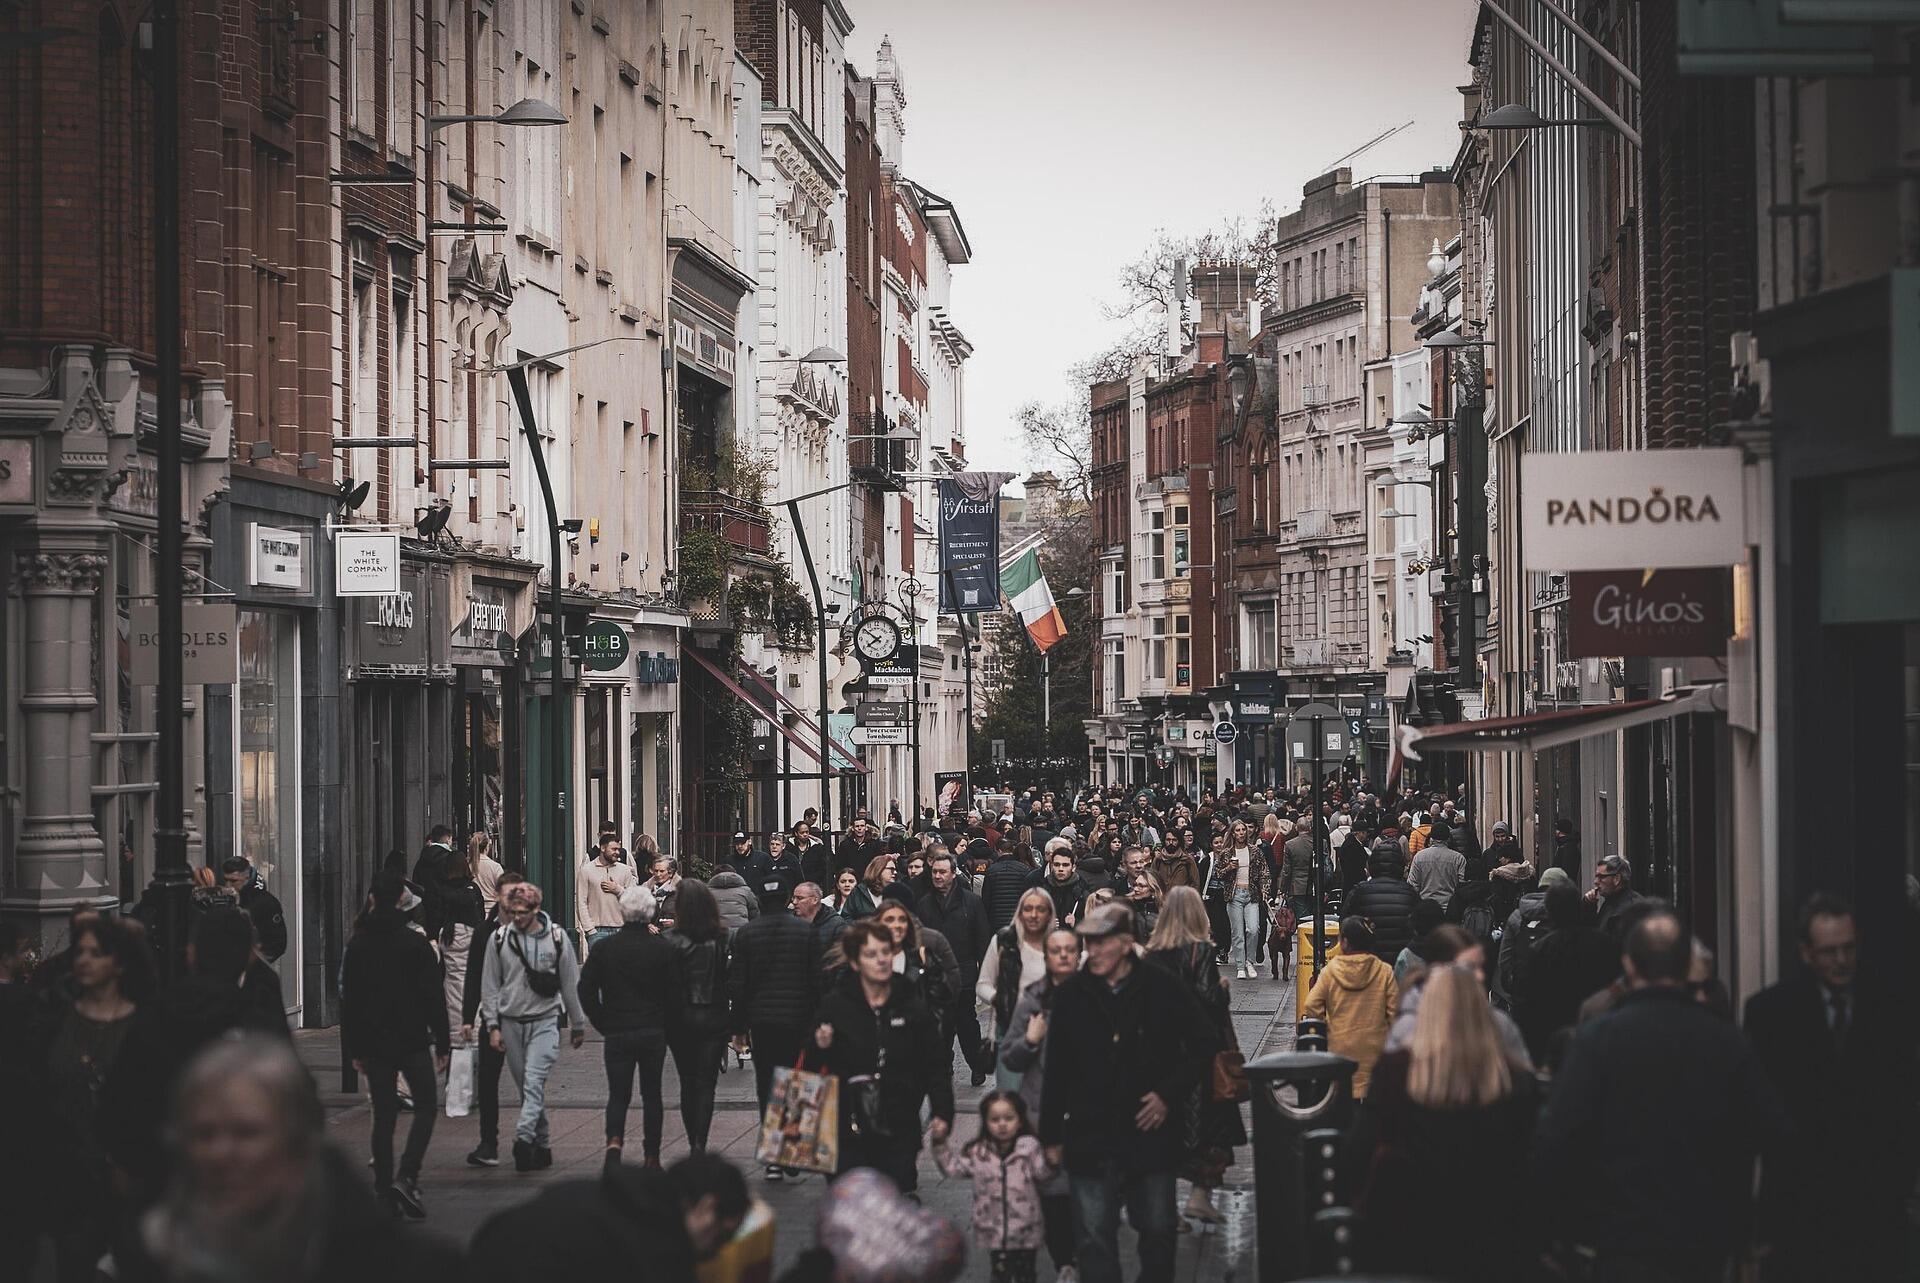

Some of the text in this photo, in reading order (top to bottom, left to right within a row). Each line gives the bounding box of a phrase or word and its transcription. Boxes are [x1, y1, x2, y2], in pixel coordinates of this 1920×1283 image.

[1546, 493, 1721, 526] PANDORA
[360, 549, 376, 557] THE
[1592, 584, 1705, 630] Gino's
[139, 632, 228, 647] BODLES
[874, 665, 911, 673] MacMahon
